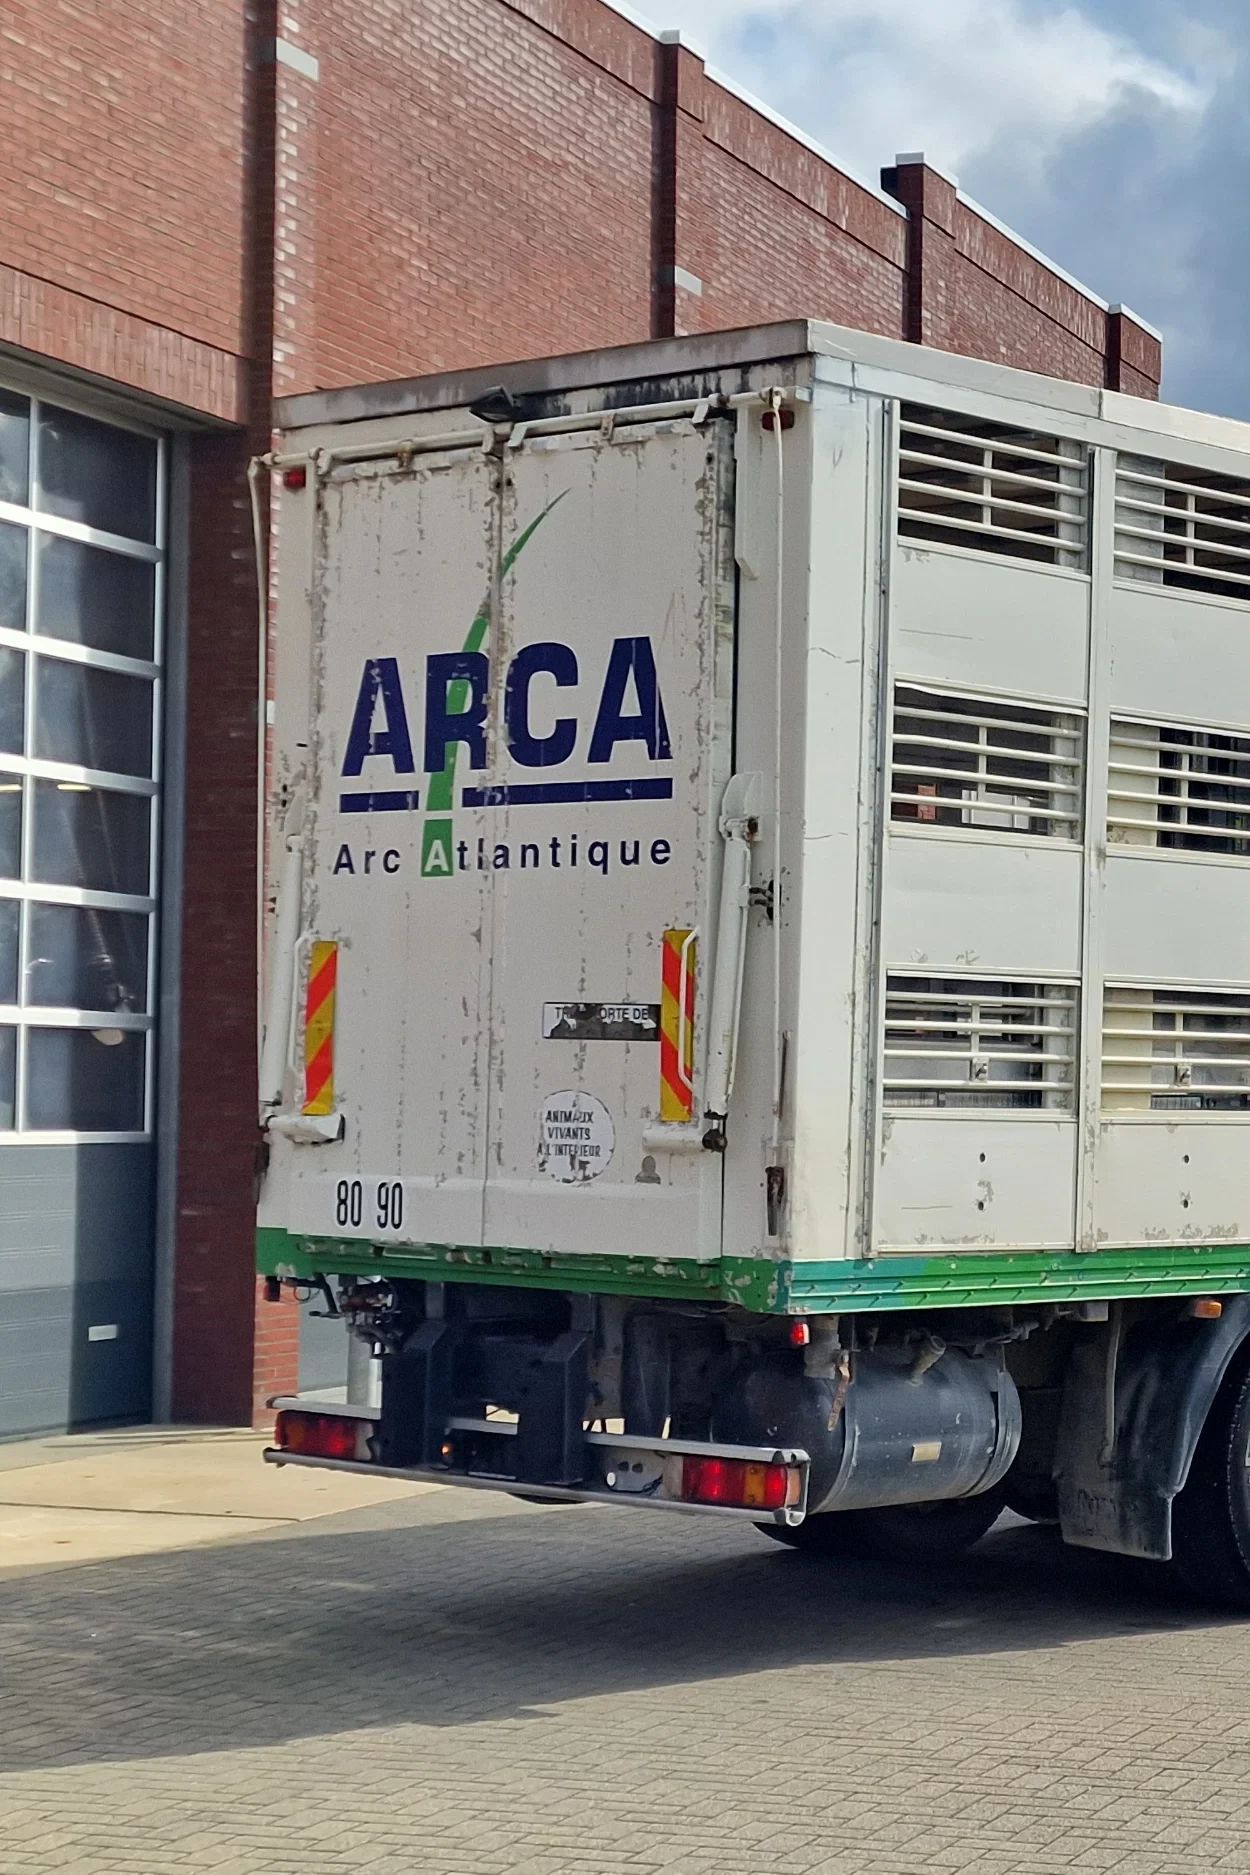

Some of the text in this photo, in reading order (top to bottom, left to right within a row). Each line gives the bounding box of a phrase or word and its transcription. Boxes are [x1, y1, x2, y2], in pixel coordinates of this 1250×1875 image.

[341, 636, 673, 777] ARCA
[333, 834, 671, 876] Arc Atlantique
[547, 1127, 591, 1140] VIVANTS
[337, 1180, 402, 1230] 80 90
